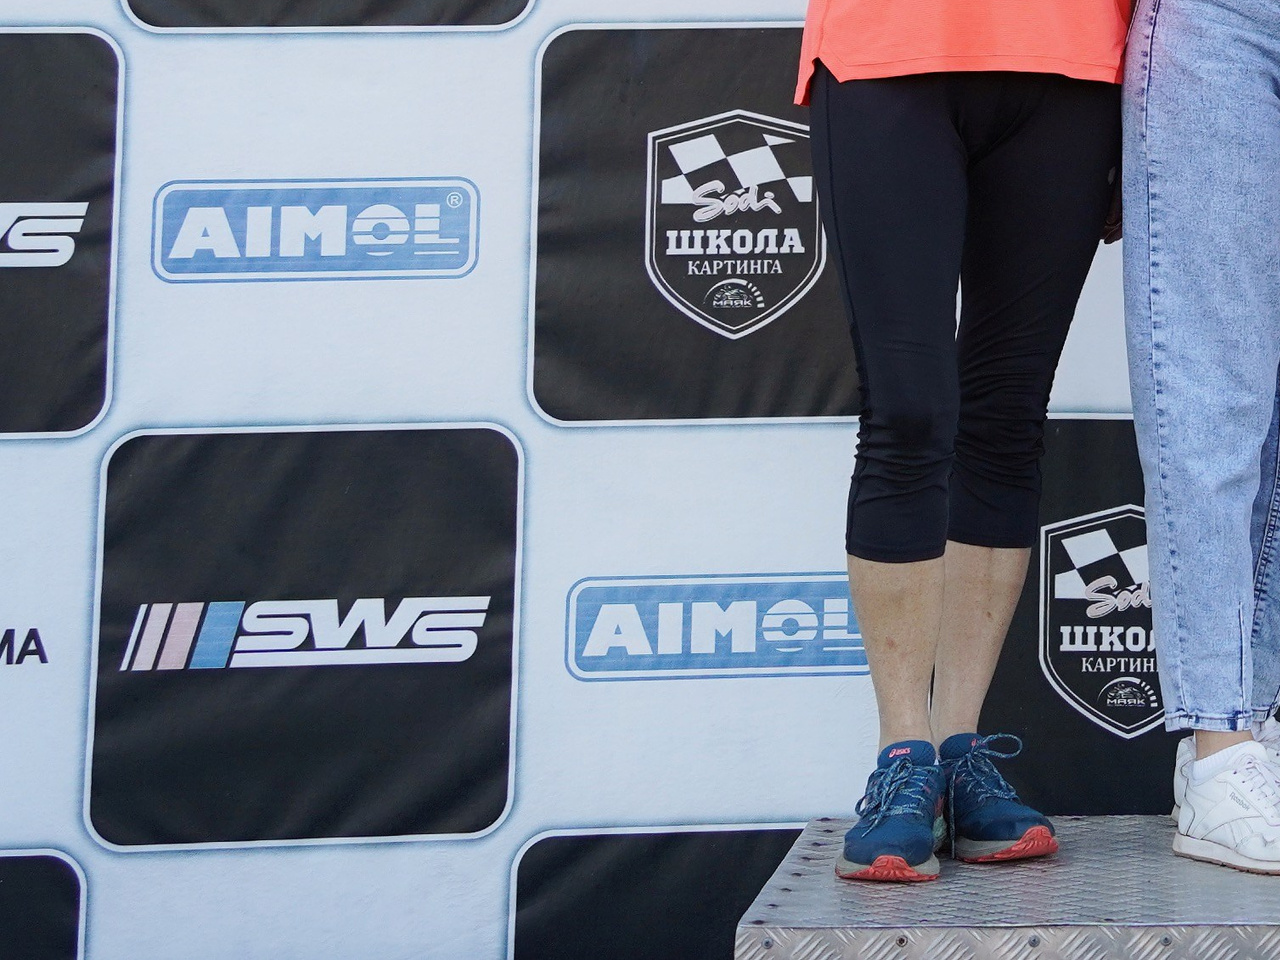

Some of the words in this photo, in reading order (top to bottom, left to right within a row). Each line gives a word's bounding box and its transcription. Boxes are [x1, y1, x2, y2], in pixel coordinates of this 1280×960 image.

[692, 180, 782, 222] Sodi
[666, 228, 805, 256] ШКОЛА
[687, 259, 783, 275] КАРТИНГА
[1085, 575, 1152, 618] Sod
[230, 596, 491, 668] SWS
[1060, 626, 1157, 652] ШКО
[1081, 657, 1158, 672] КАРТИН
